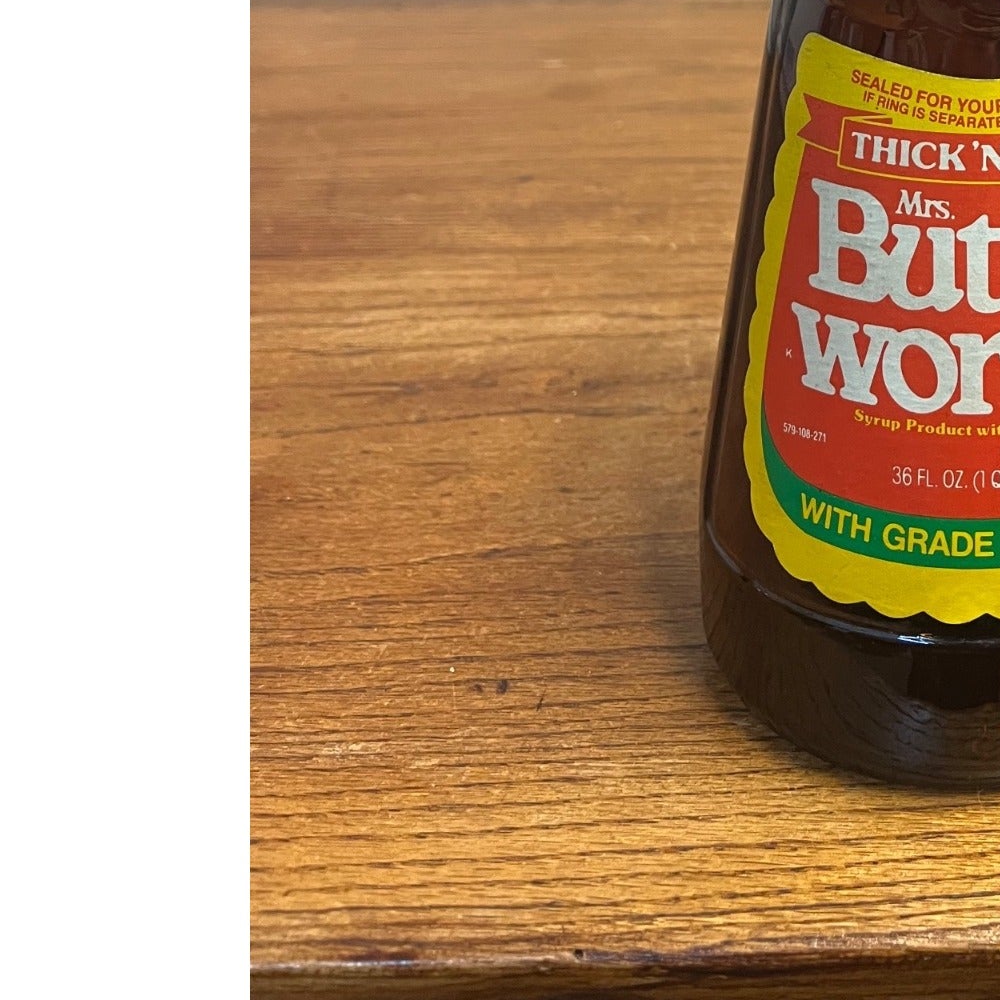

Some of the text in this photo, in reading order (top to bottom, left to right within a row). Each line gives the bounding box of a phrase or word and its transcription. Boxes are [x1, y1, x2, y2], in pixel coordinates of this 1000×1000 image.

[851, 69, 913, 100] SEALED
[916, 89, 953, 110] FOR
[863, 90, 875, 103] IF
[876, 95, 909, 115] RING
[911, 106, 925, 119] IS
[851, 131, 966, 171] THICK
[895, 188, 955, 220] Mrs.
[783, 422, 827, 443] 579-108-271
[853, 408, 901, 431] Syrup
[906, 418, 972, 436] Product
[892, 466, 913, 487] 36
[917, 468, 938, 488] FL.
[942, 469, 968, 489] OZ.
[973, 469, 986, 494] (1
[800, 492, 872, 542] WITH
[882, 523, 994, 558] GRADE
